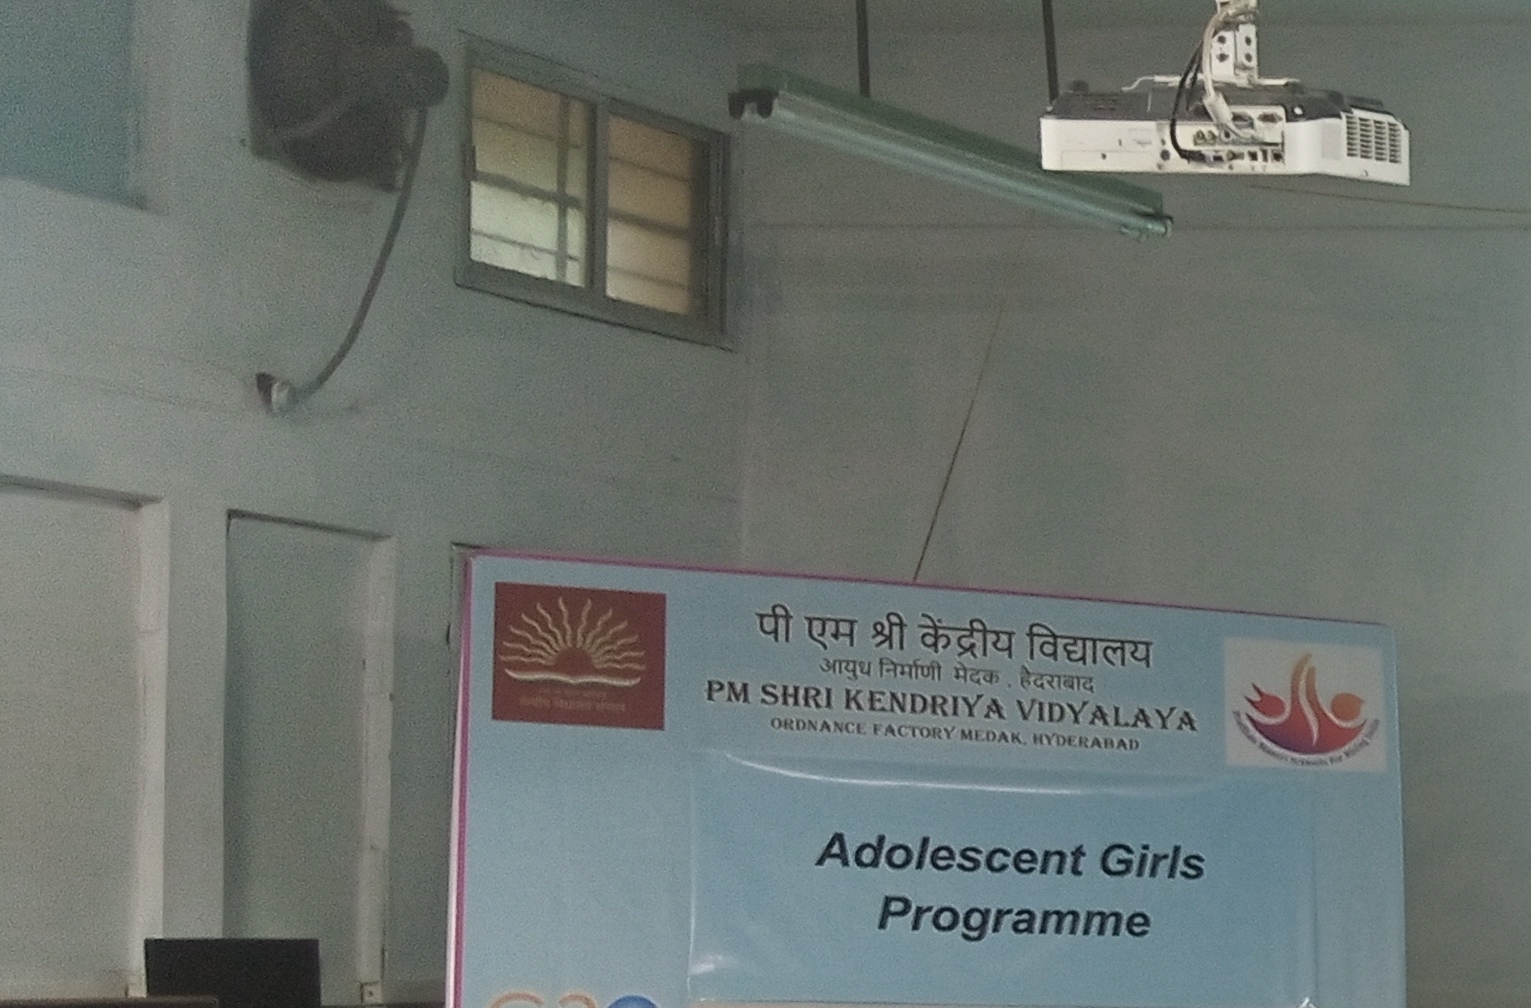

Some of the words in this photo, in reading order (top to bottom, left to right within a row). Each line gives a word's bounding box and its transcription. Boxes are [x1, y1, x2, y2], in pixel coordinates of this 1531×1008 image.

[755, 603, 793, 643] पी
[804, 615, 858, 650] एम
[872, 611, 907, 651] श्री
[918, 612, 1016, 660] केंद्रीय
[1026, 622, 1154, 668] विद्यालय
[819, 658, 872, 681] आयुध
[879, 657, 942, 681] निर्माणी
[706, 679, 750, 704] PM
[760, 683, 833, 710] SHRI
[844, 688, 1006, 721] KENDRIYA
[1016, 698, 1198, 732] VIDYALAYA
[770, 717, 867, 736] ORDNANCE
[873, 723, 956, 740] FACTORY
[1032, 733, 1140, 751] HYDERABAD
[814, 831, 1087, 877] Adolescent
[1100, 842, 1206, 881] Girls
[877, 894, 1151, 942] Programme
